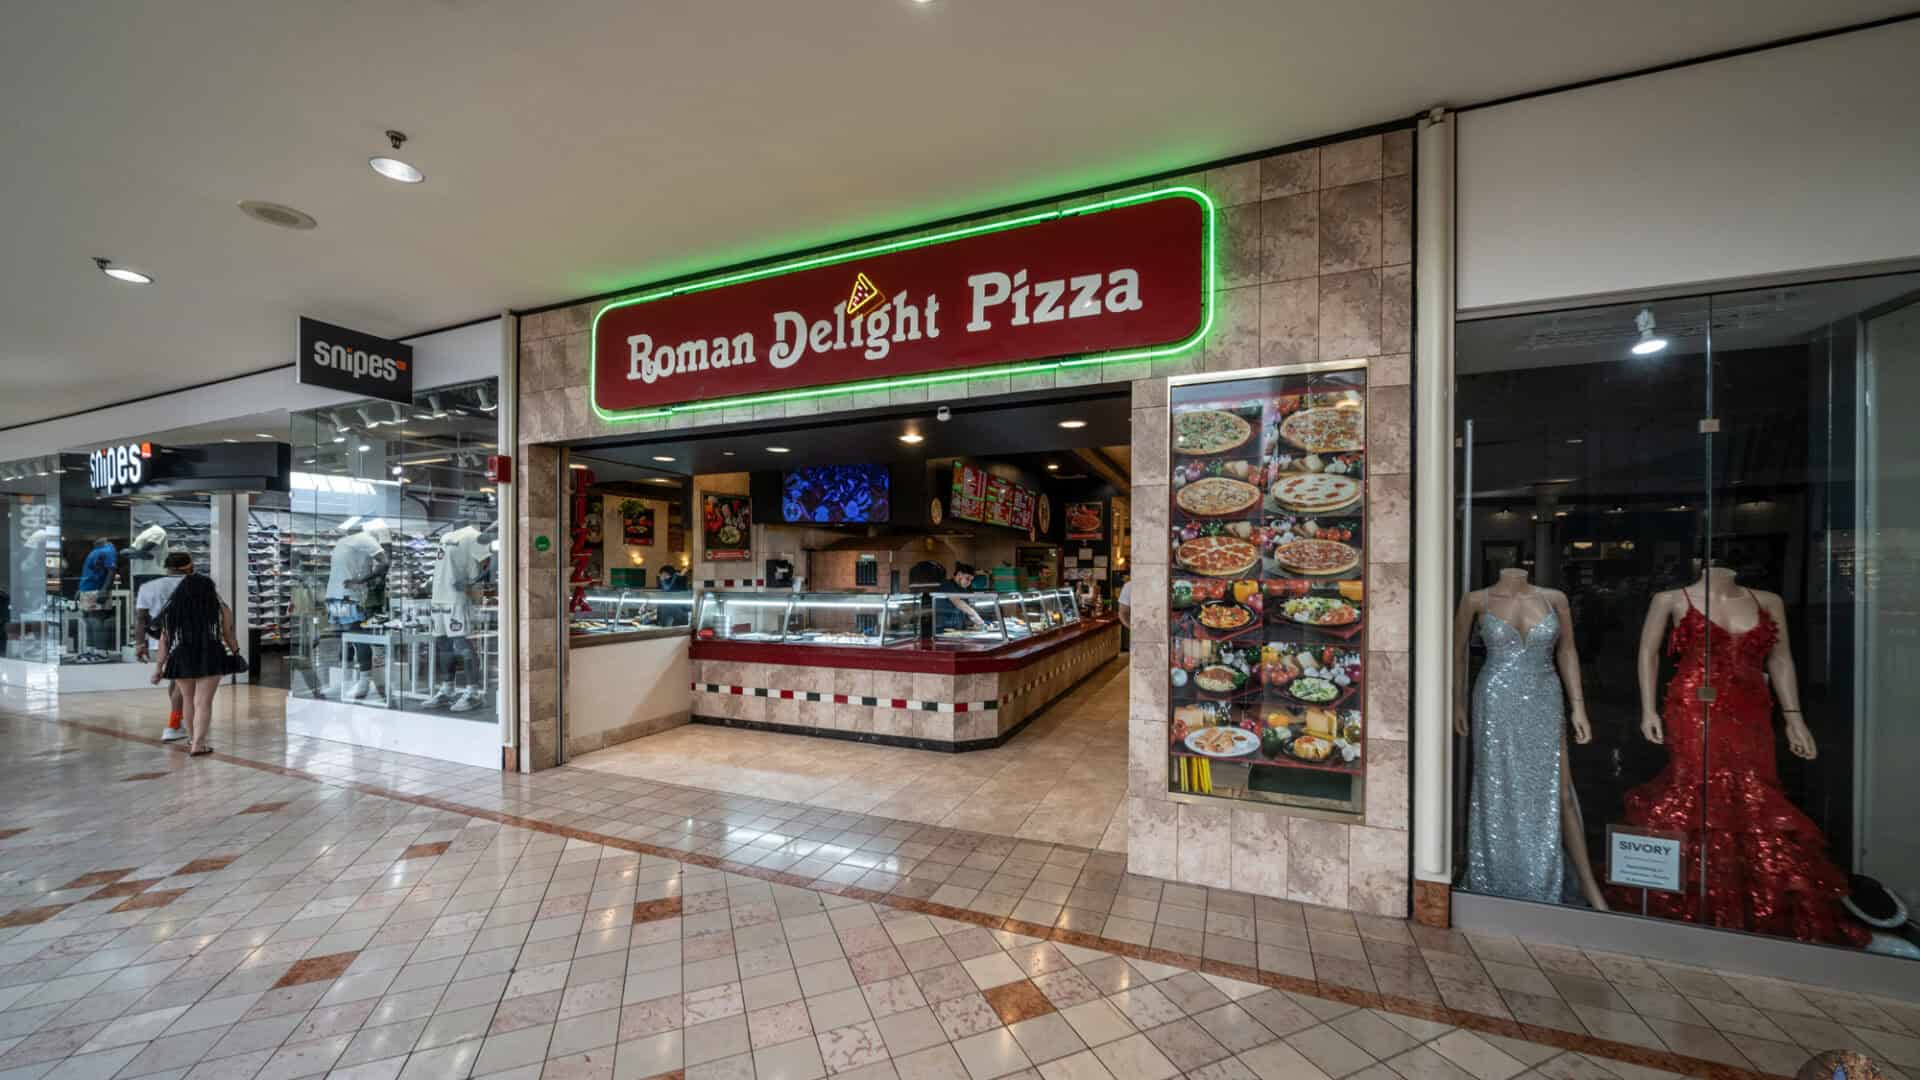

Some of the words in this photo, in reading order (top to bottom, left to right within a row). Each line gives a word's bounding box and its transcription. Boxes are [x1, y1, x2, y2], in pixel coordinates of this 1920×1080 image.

[626, 332, 757, 384] Roman
[768, 289, 940, 369] Delight
[966, 268, 1143, 332] Pizza
[314, 340, 397, 381] snipes
[89, 443, 142, 495] snipes
[1619, 841, 1672, 855] SIVORY
